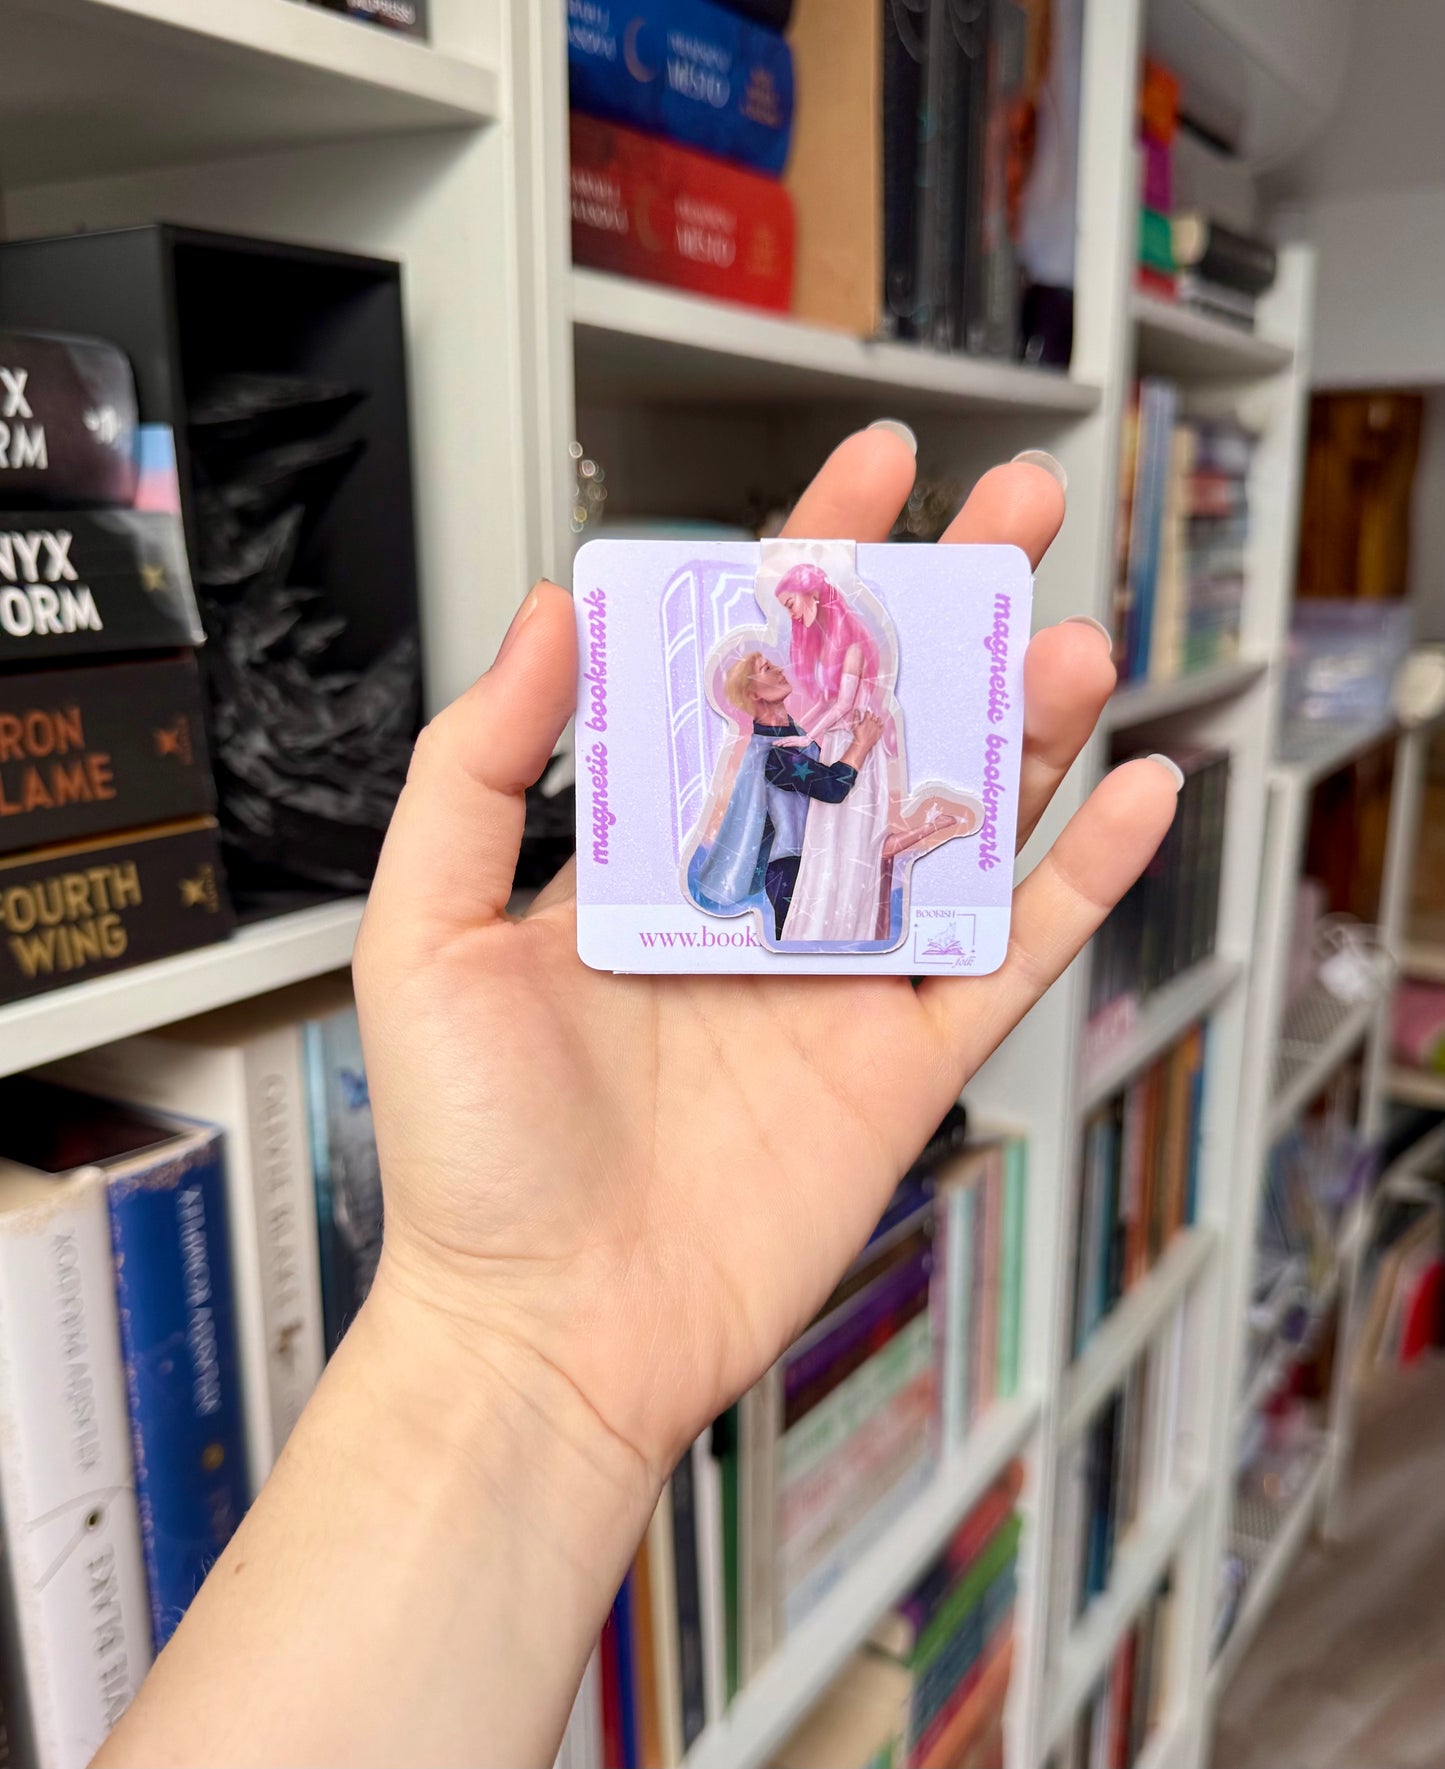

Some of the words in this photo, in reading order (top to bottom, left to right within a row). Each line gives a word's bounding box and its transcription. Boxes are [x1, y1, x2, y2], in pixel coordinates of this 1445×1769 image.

[0, 529, 79, 582] NYX
[0, 584, 103, 637] ORM
[583, 587, 607, 732] bookmark
[983, 593, 1011, 725] magnetic
[0, 706, 84, 762] RON
[0, 753, 117, 817] LAME
[586, 741, 616, 865] magnetic
[978, 733, 1009, 872] bookmark
[0, 860, 143, 934] OURTH
[9, 912, 128, 979] WING
[638, 925, 763, 948] www.book
